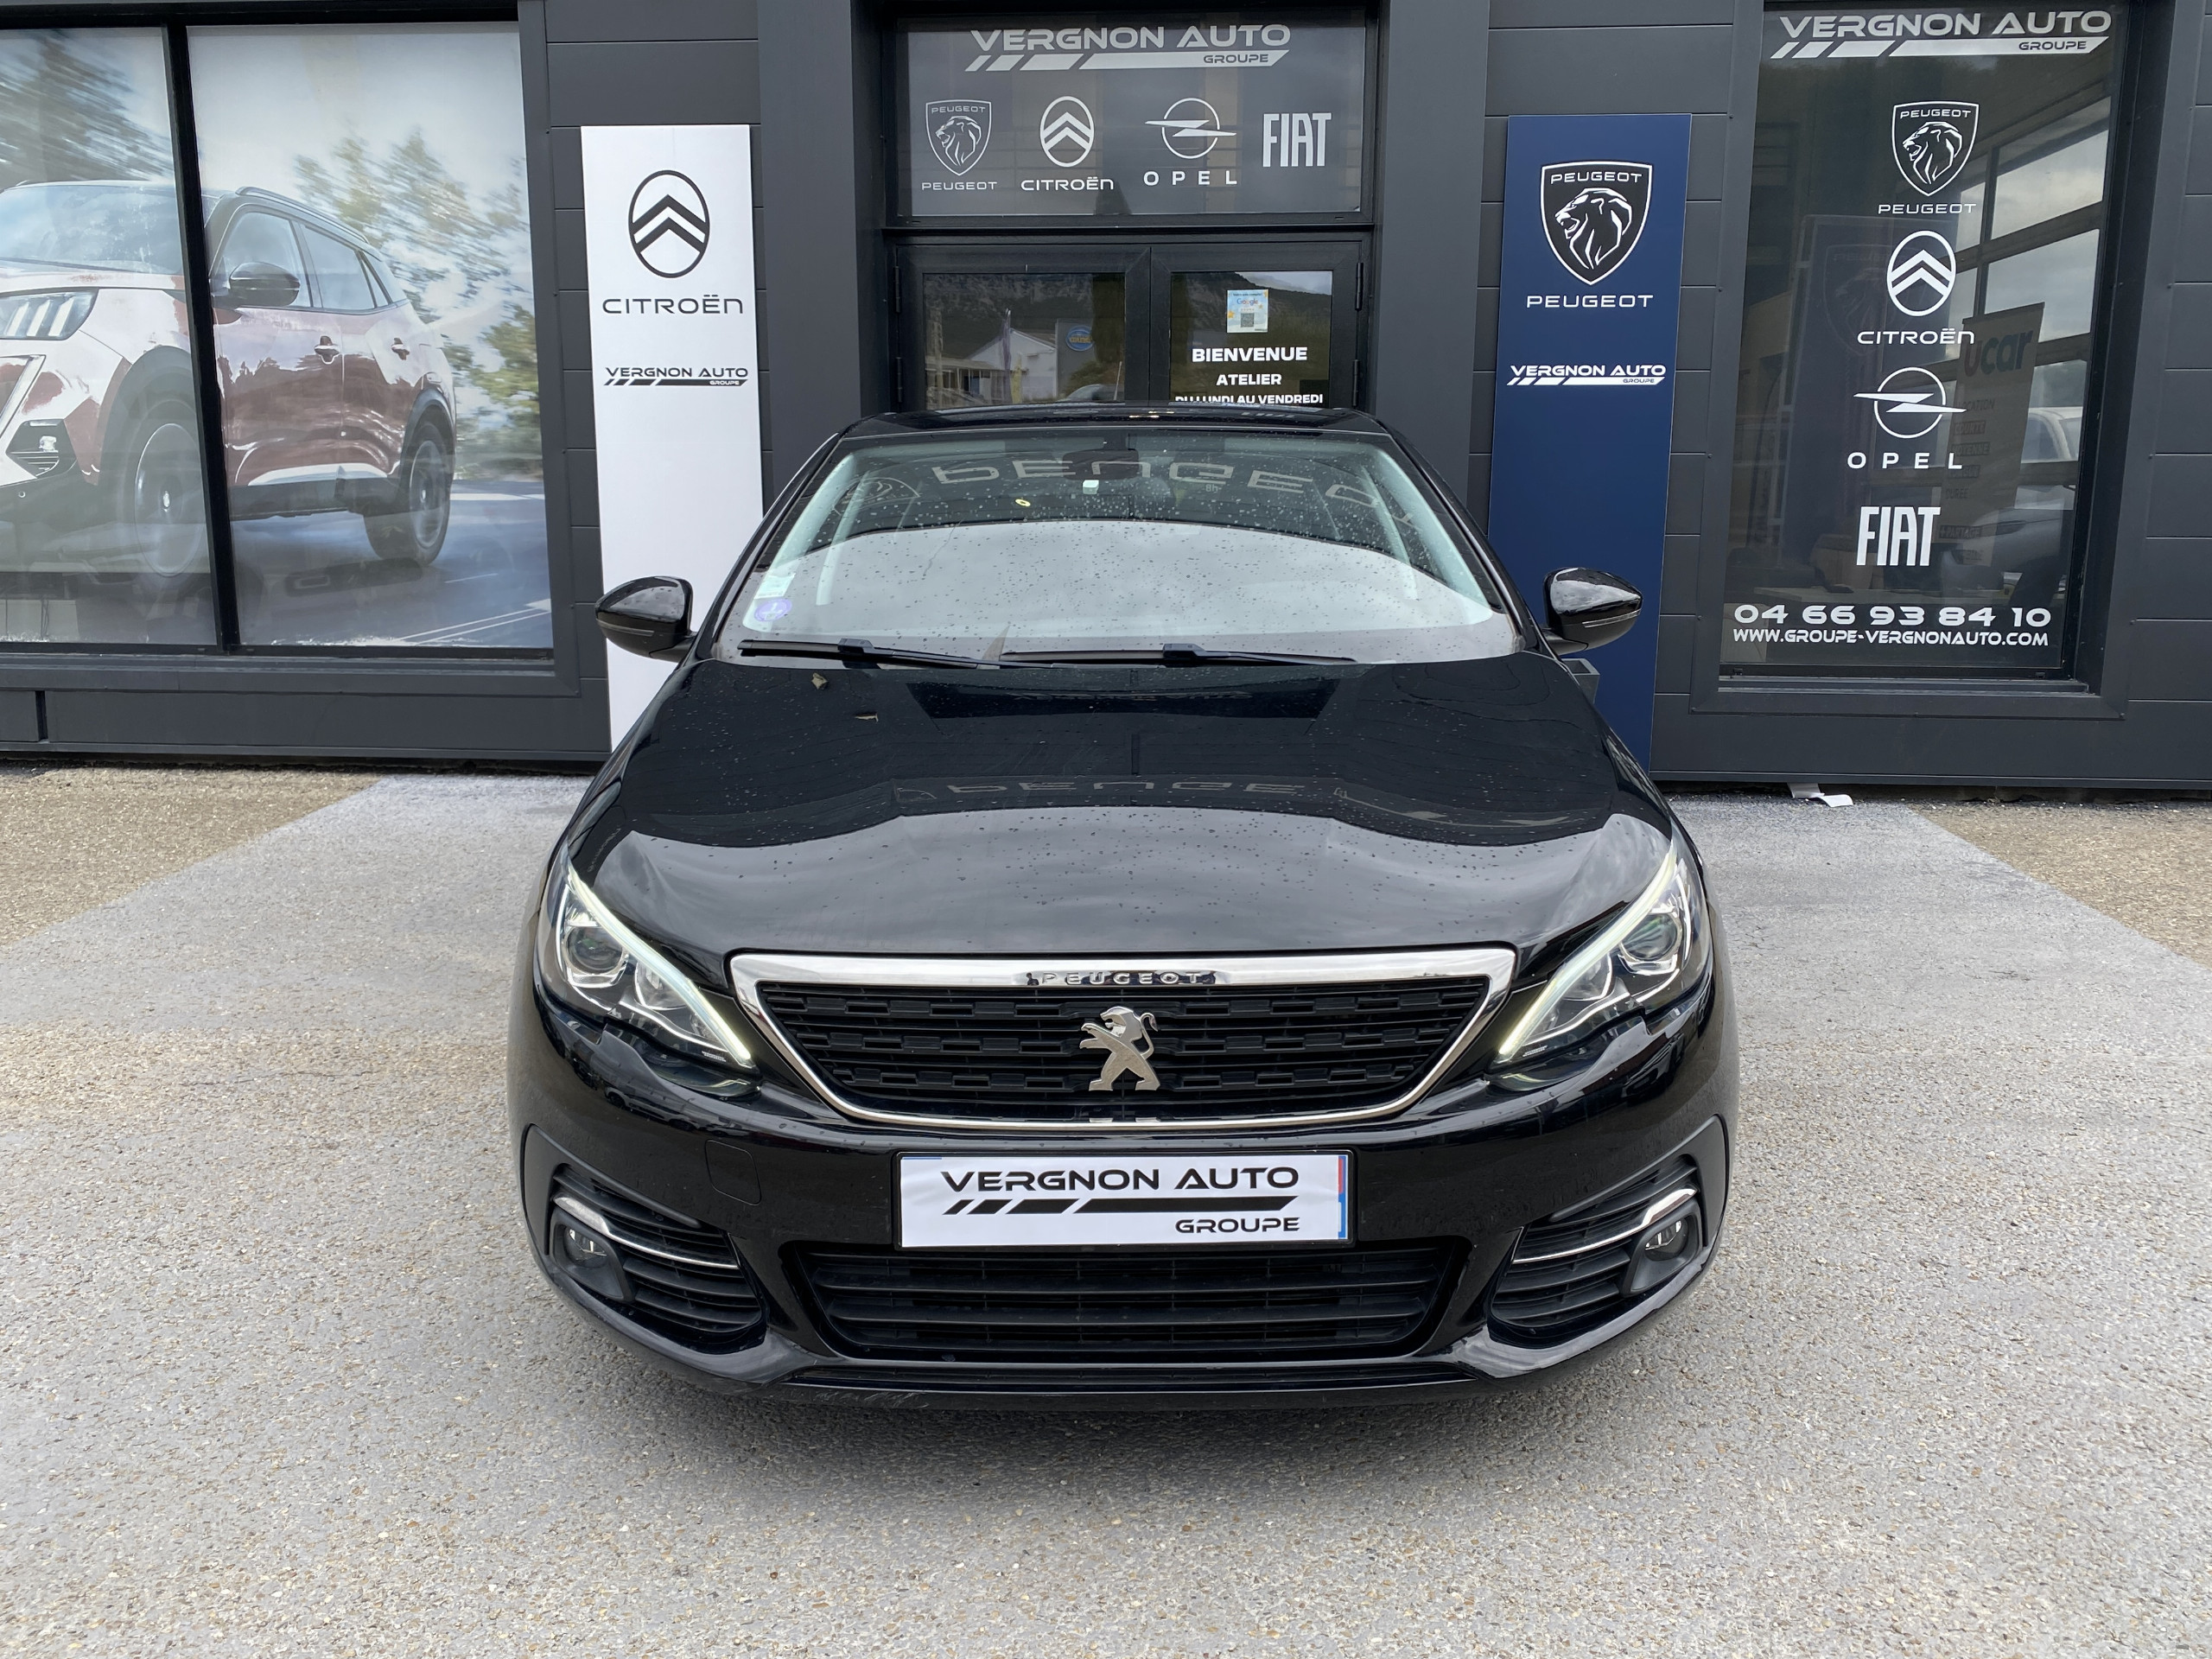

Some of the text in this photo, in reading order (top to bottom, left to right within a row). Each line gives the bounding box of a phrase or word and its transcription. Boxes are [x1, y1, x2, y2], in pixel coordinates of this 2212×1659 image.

[1780, 10, 2112, 39] VERGNON AUTO
[970, 24, 1291, 51] VERGNON AUTO
[2018, 41, 2087, 51] GROUPE
[1203, 54, 1269, 64] GROUPE
[931, 105, 986, 114] PEUGEOT
[1900, 109, 1972, 119] PEUGEOT
[1262, 113, 1332, 168] FIAT
[1550, 171, 1643, 184] PEUGEOT
[921, 181, 998, 190] PEUGEOT
[1878, 203, 1977, 214] PEUGEOT
[1526, 295, 1654, 308] PEUGEOT
[1192, 346, 1308, 362] BIENVENUE
[606, 367, 748, 378] VERGNON AUTO
[1510, 365, 1667, 377] VERGNON AUTO
[1216, 373, 1282, 386] ATELIER
[1258, 394, 1324, 404] VENDREDI
[1856, 506, 1942, 567] FIAT
[1734, 604, 2051, 627] 04 66 93 84 10
[1733, 628, 2049, 646] WWW.GROUPE-VERGNONAUTO.COM
[1041, 971, 1202, 985] PEUGEOT
[941, 1166, 1300, 1192] VERGNON AUTO
[1175, 1217, 1300, 1234] GROUPE
